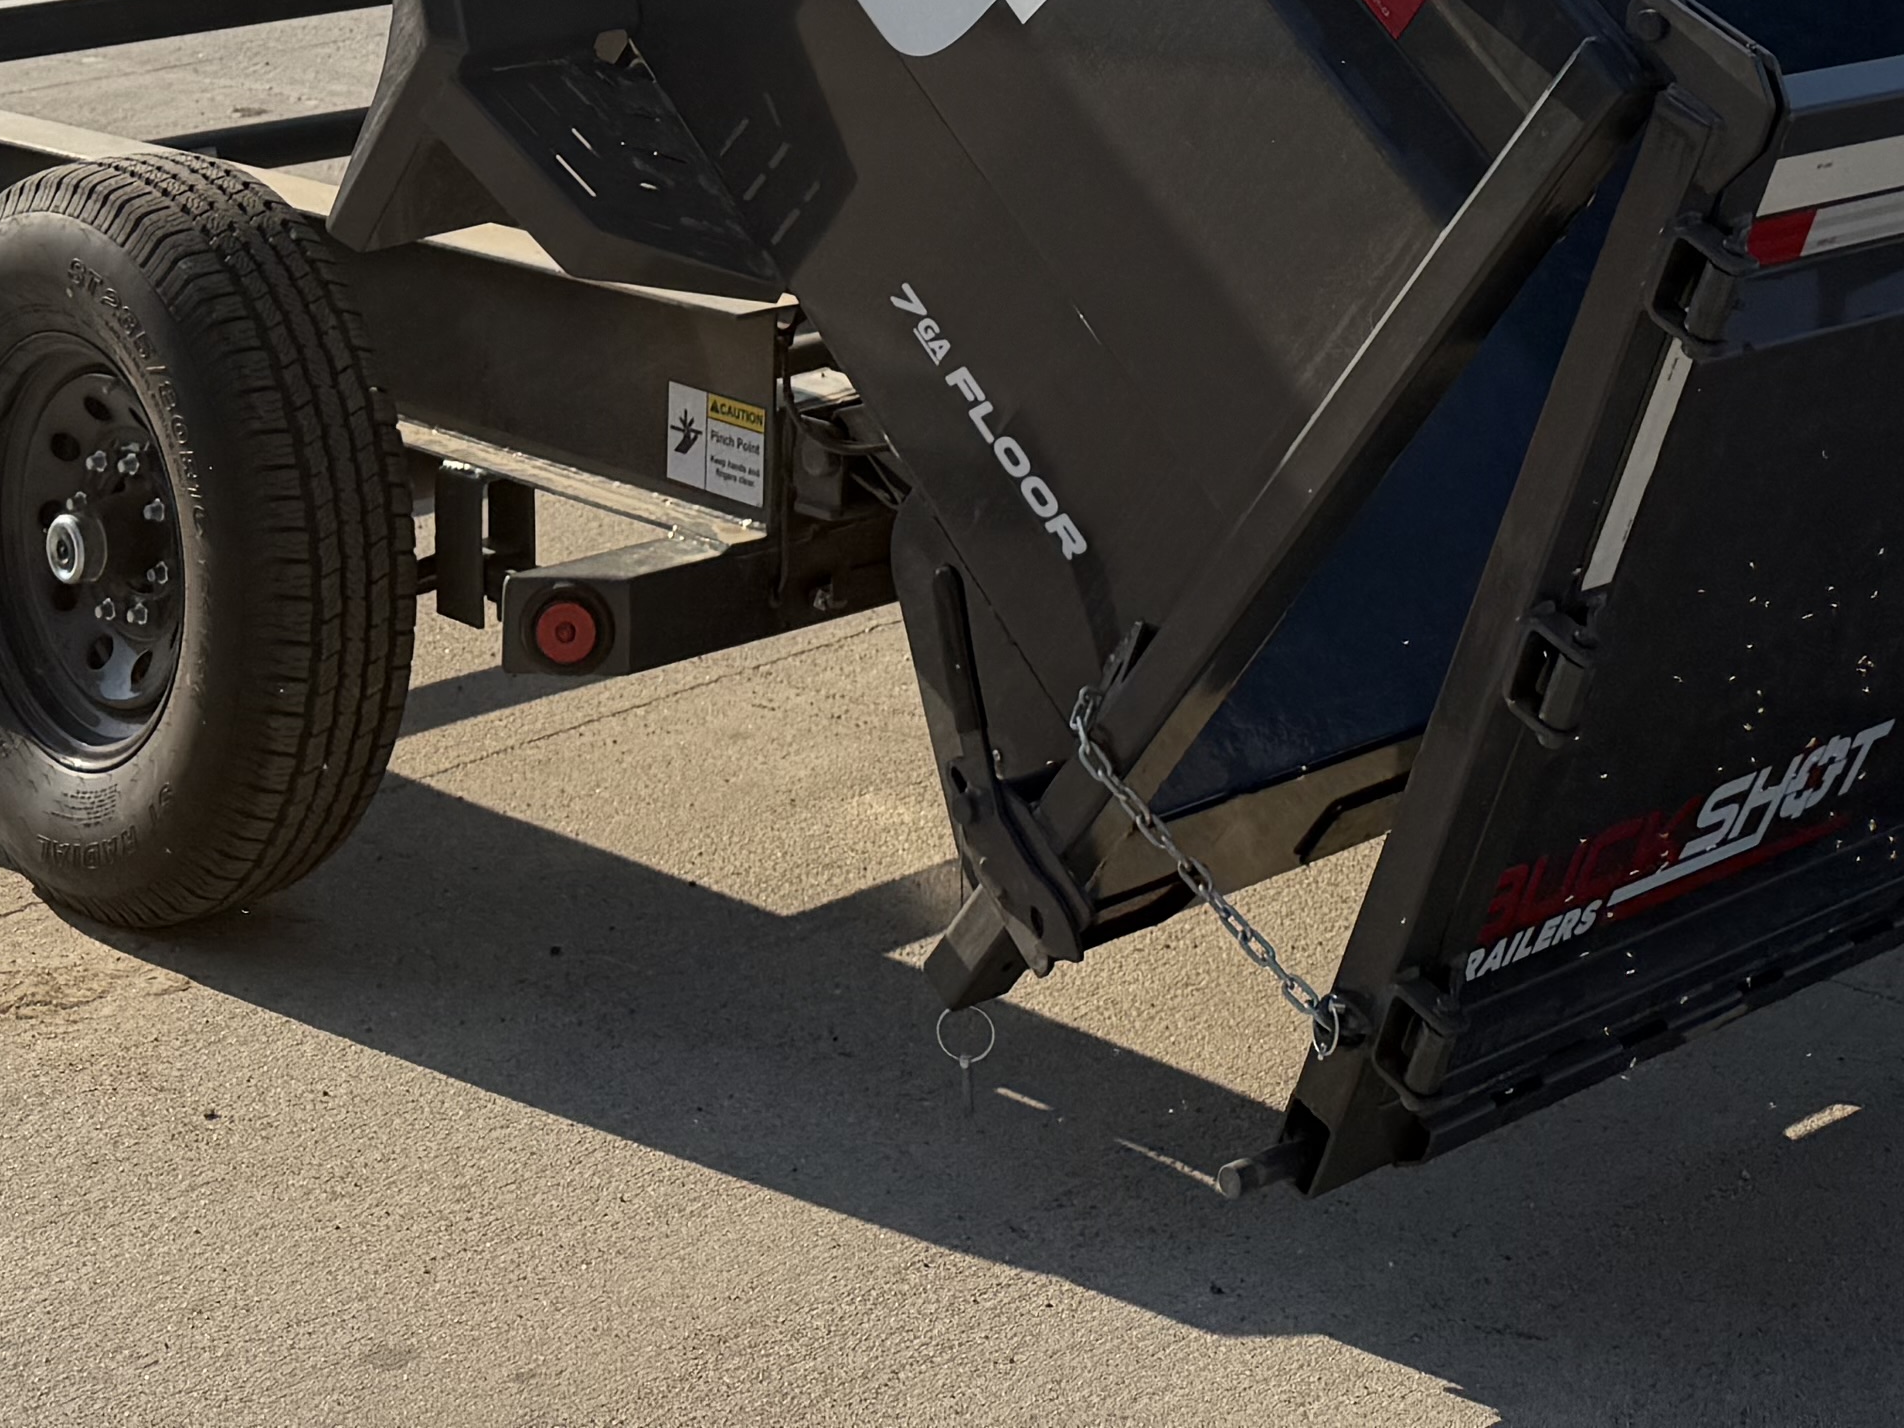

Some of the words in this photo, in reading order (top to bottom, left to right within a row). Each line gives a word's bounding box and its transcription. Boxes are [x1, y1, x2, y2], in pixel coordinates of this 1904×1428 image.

[720, 402, 764, 426] CAUTION
[710, 429, 735, 447] Pinch
[736, 437, 761, 455] Point
[945, 365, 1088, 561] FLOOR
[1464, 898, 1604, 982] RAILERS
